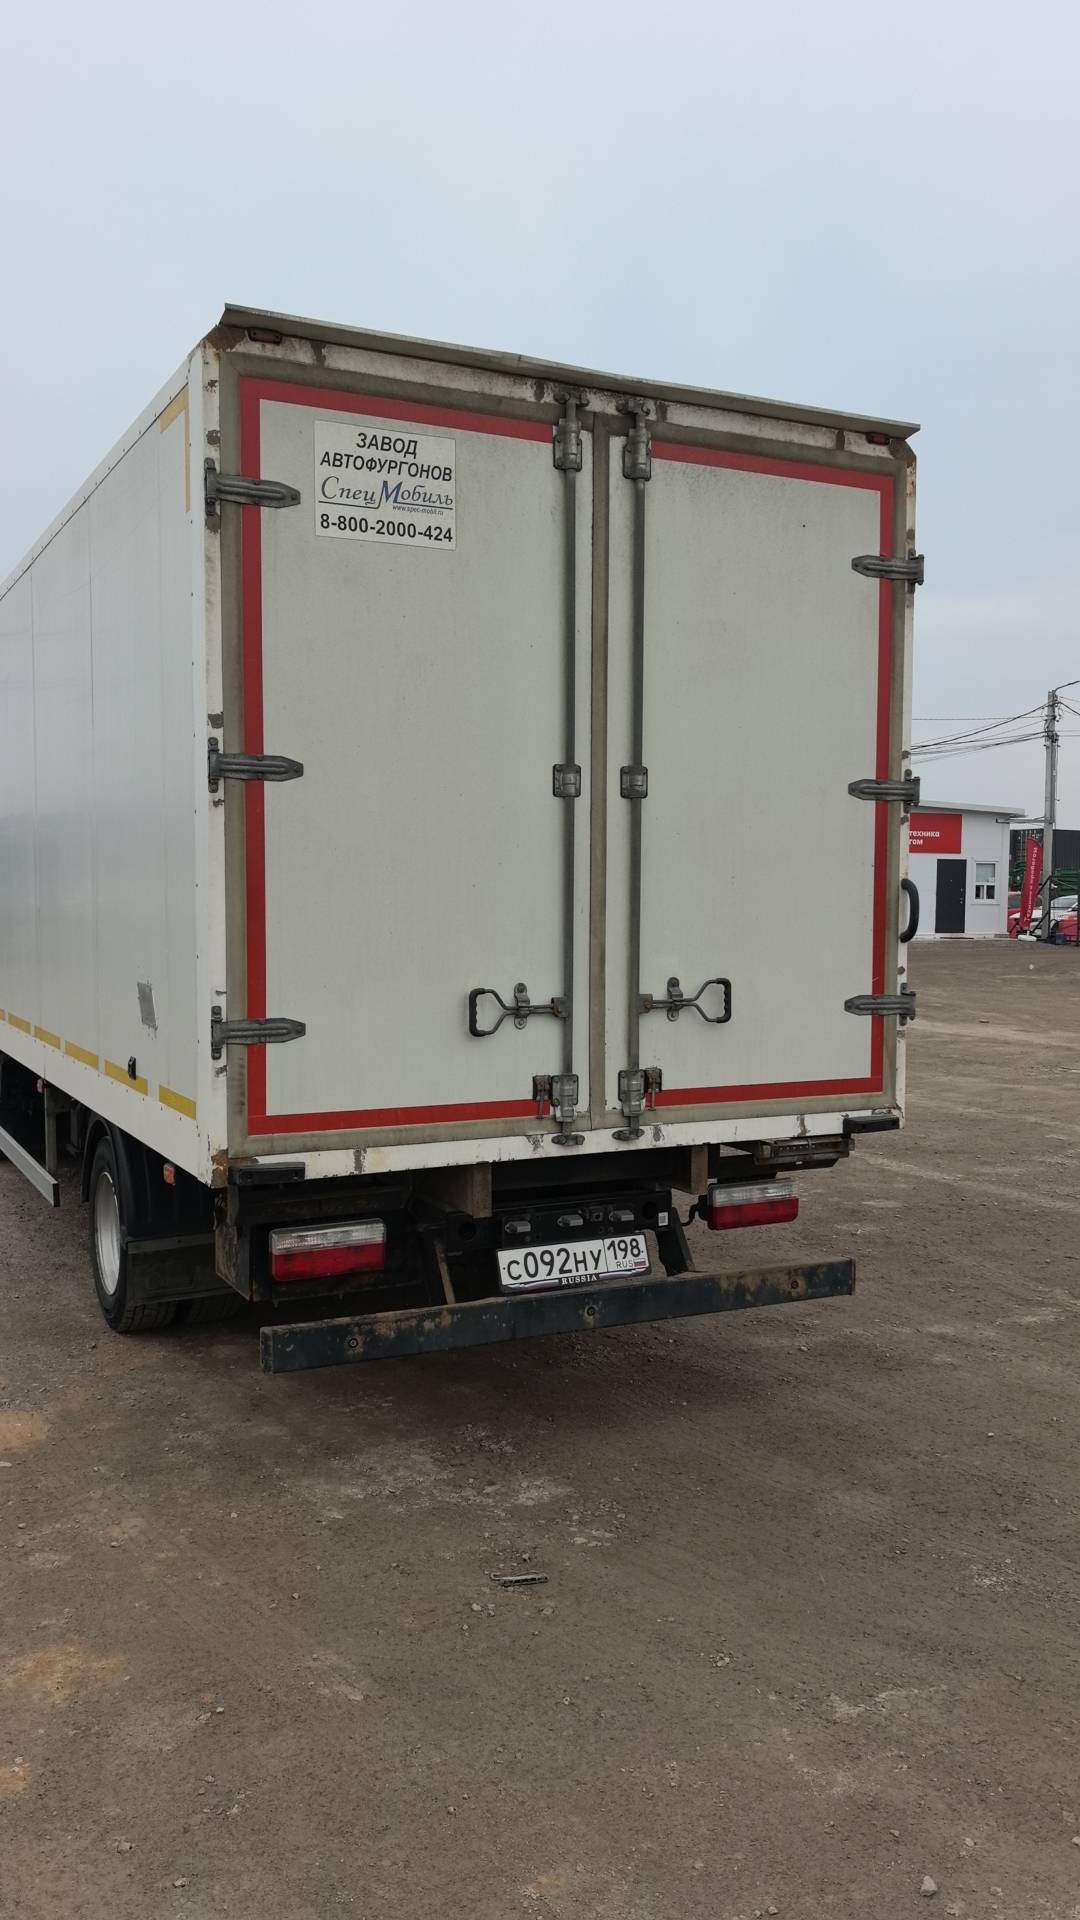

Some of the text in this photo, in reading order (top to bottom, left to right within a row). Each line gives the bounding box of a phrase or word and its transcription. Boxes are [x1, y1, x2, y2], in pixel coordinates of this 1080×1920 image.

[356, 432, 418, 459] ЗАВОД
[320, 451, 452, 482] АВТОФУРГОНОВ
[320, 513, 453, 542] 8-800-2000-424
[507, 1238, 641, 1280] С092НУ 198
[616, 1259, 634, 1268] RUS
[561, 1274, 598, 1285] RUSSIA
